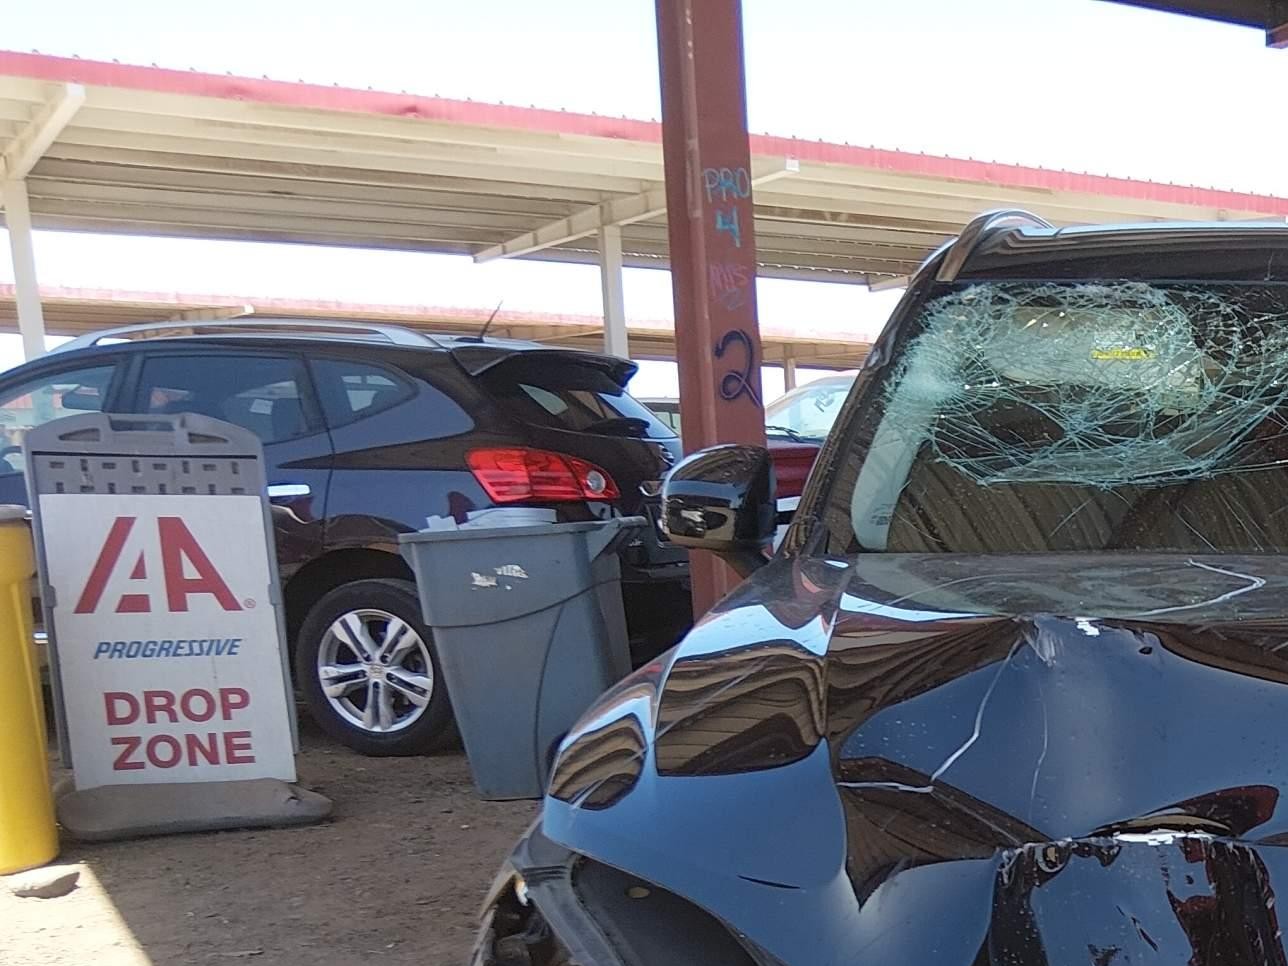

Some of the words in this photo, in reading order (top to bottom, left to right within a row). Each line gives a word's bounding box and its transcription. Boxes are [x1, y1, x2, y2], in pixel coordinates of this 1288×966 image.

[715, 206, 741, 248] 4
[714, 329, 762, 408] 2
[94, 638, 242, 660] PROGRESSIVE
[104, 687, 250, 726] DROP
[111, 730, 256, 771] ZONE
